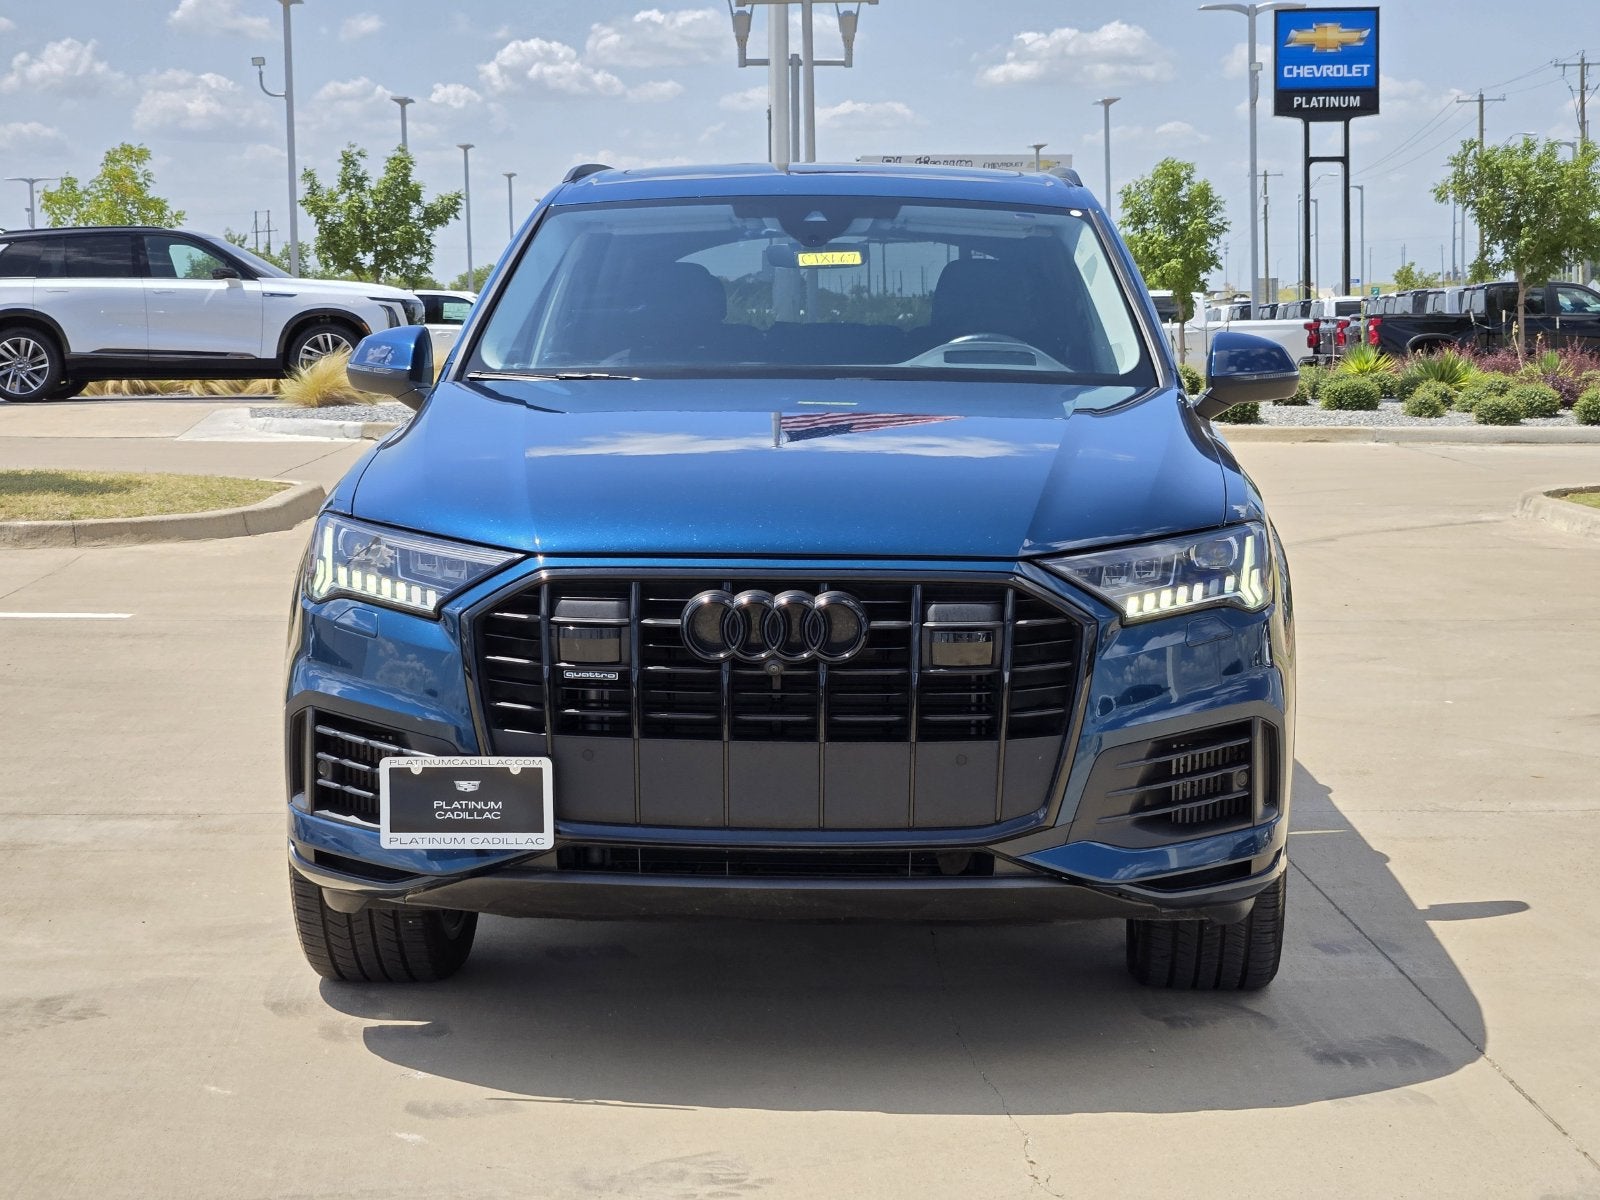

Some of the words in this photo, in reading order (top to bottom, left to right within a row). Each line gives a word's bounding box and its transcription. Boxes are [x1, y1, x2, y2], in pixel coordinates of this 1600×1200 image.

[1283, 64, 1371, 78] CHEVROLET
[1293, 96, 1360, 108] PLATINUM
[565, 671, 616, 679] quattro
[433, 800, 503, 809] PLATINUM
[435, 811, 501, 820] CADILLAC
[389, 837, 466, 845] PLATINUM
[470, 837, 545, 845] CADILLAC
